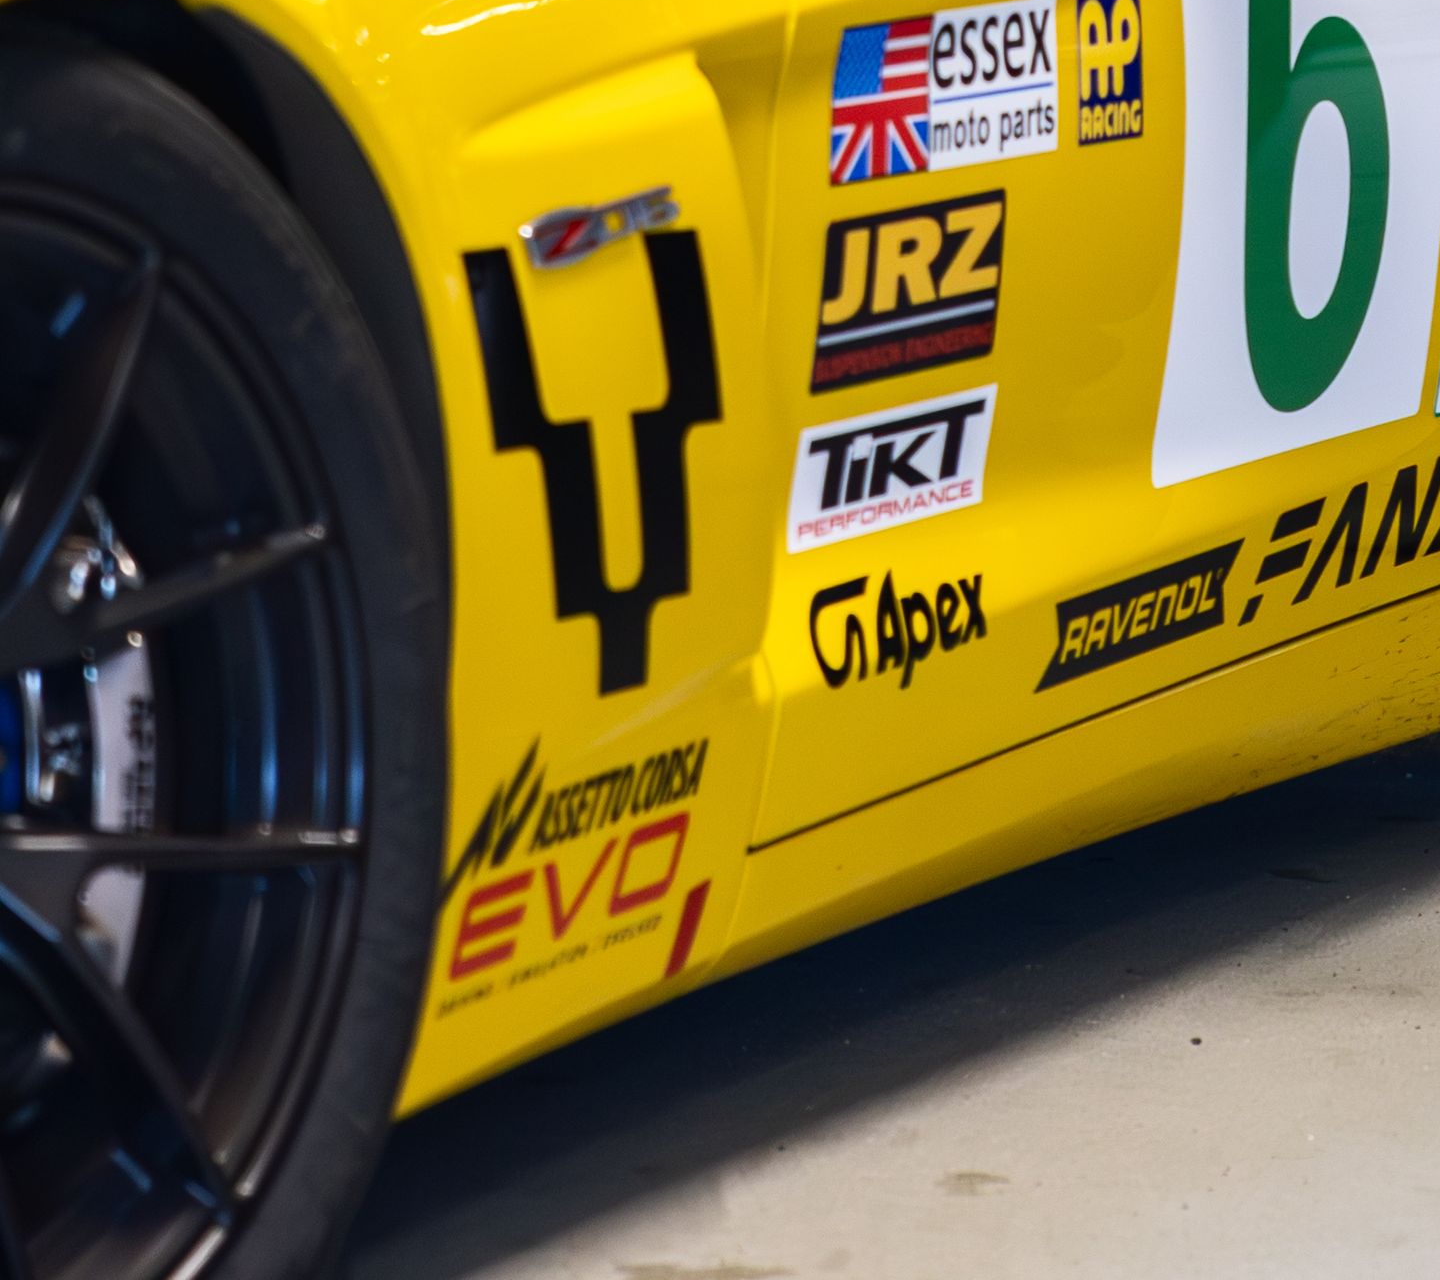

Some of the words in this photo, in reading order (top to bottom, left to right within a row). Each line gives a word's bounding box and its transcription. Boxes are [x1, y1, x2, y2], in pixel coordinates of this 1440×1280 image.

[932, 6, 1053, 89] essex
[933, 108, 990, 151] moto
[999, 98, 1055, 152] parts
[1080, 99, 1142, 140] RACING
[821, 201, 1003, 325] JRZ
[797, 478, 974, 539] PERFORMANCE
[877, 568, 987, 689] Apex
[1058, 570, 1218, 665] RAVENOL
[530, 764, 636, 852] ASSETTO
[631, 738, 709, 807] CORSA
[449, 810, 691, 983] EVO
